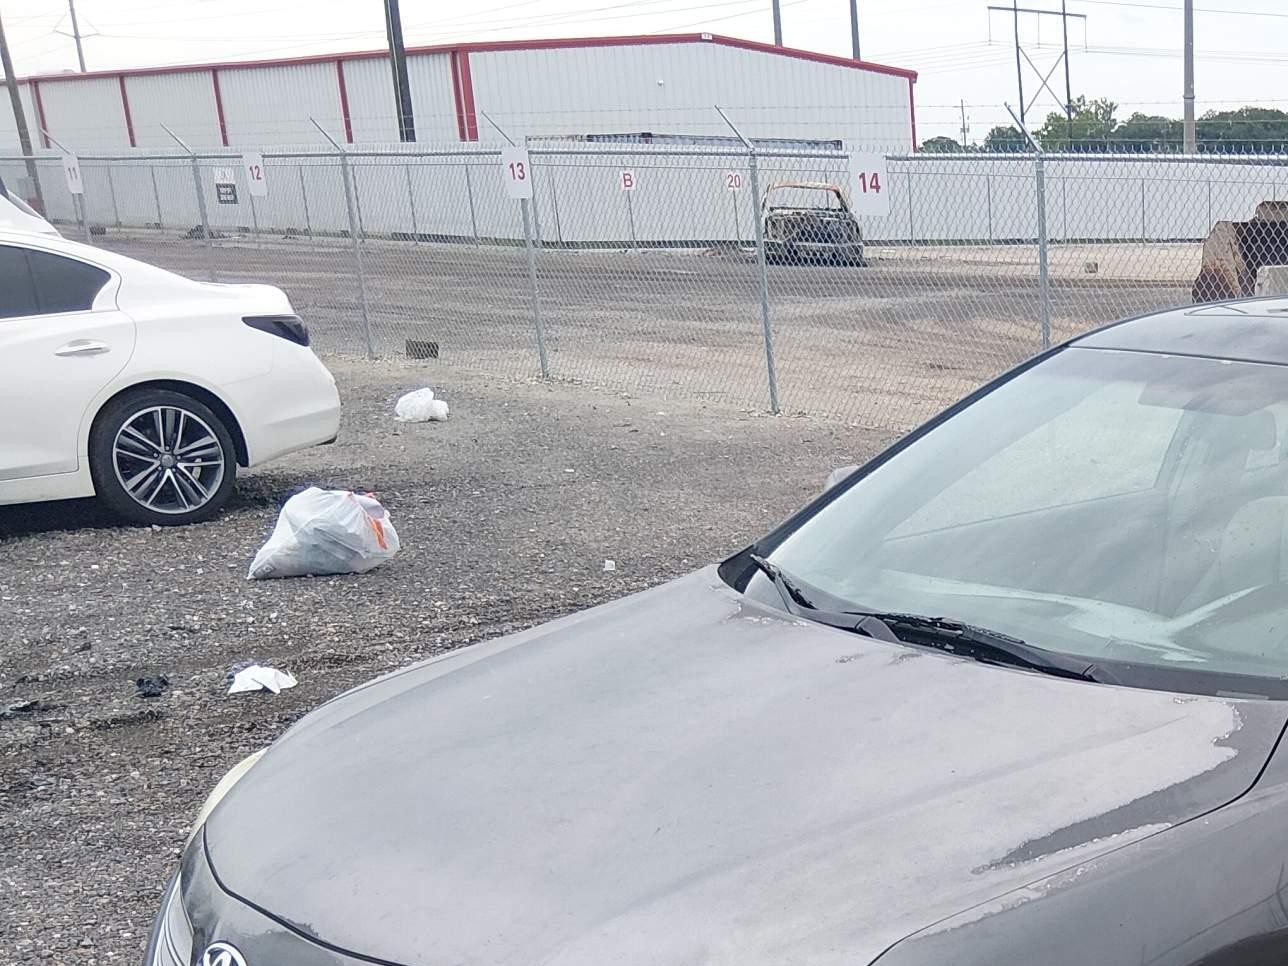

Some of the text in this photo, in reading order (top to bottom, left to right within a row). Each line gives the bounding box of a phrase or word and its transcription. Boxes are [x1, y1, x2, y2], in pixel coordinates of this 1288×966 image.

[249, 165, 262, 180] 12
[509, 162, 526, 180] 13
[622, 172, 633, 188] B
[727, 174, 741, 188] 20
[858, 172, 881, 193] 14
